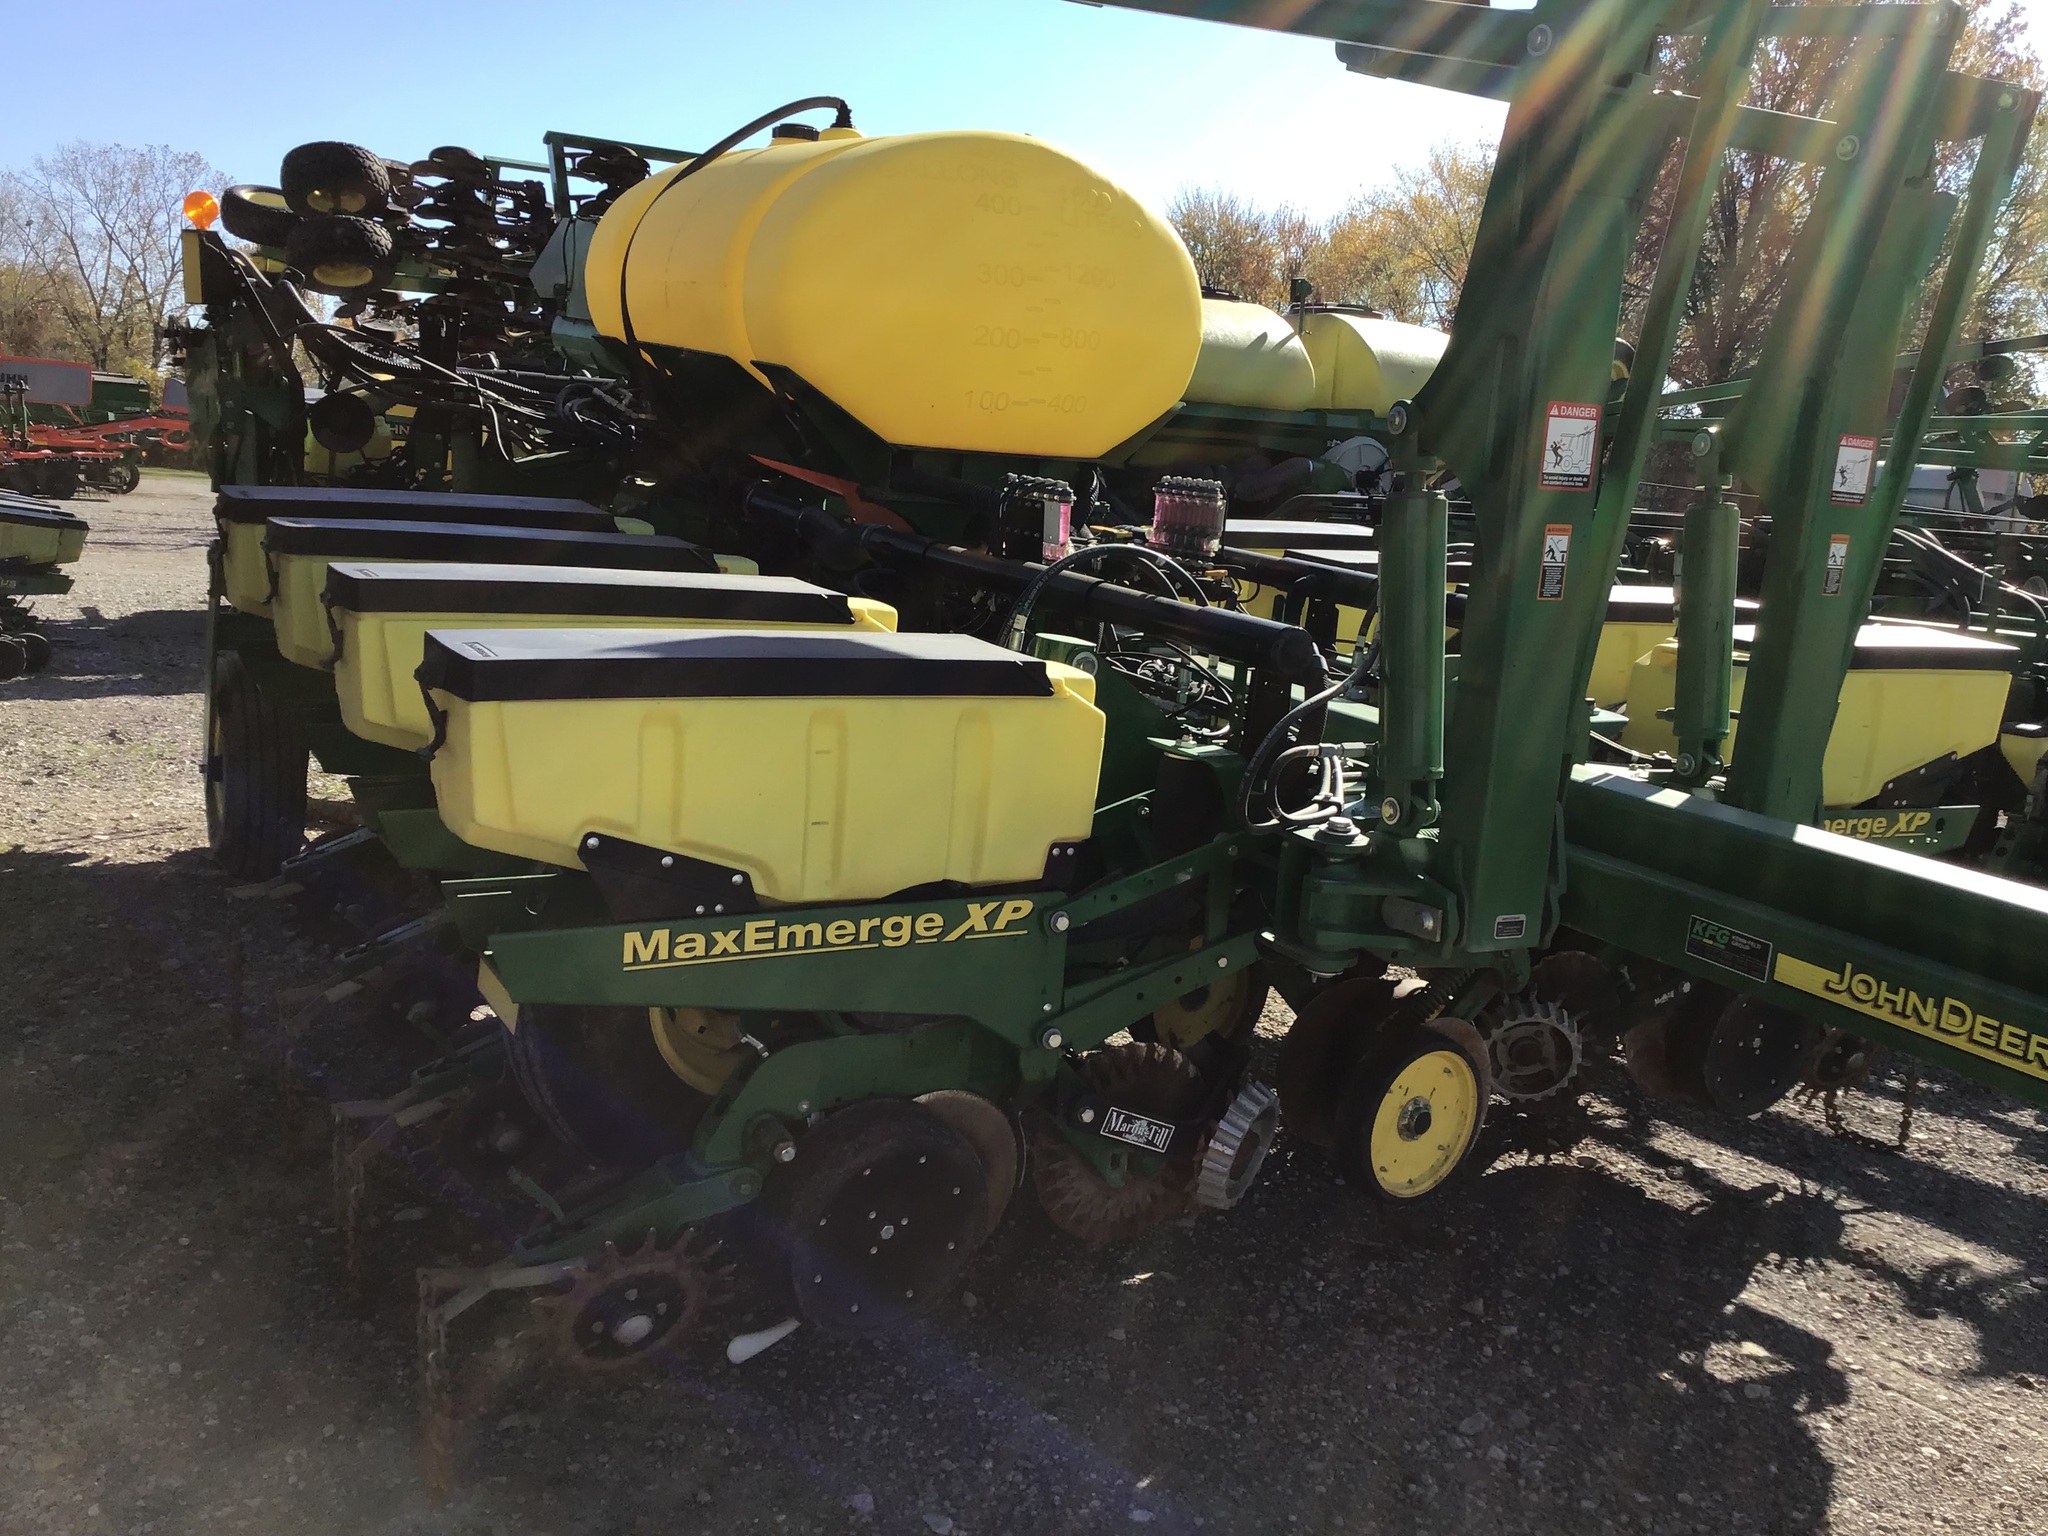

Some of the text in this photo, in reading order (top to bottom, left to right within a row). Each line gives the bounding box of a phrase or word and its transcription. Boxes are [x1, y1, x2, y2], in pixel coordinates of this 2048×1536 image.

[975, 192, 1023, 216] 400
[977, 263, 1025, 287] 300
[1064, 264, 1116, 289] 1200
[973, 325, 1021, 350] 200
[1059, 327, 1101, 350] 800
[964, 390, 1010, 411] 100
[1047, 393, 1088, 414] 400
[1560, 405, 1597, 418] DANGER
[1847, 437, 1875, 449] DANGER
[1884, 811, 1931, 838] XP
[622, 899, 1034, 964] MaxEmerge XP
[1692, 920, 1730, 945] KFG
[1827, 962, 1936, 1025] JOHN
[1148, 1125, 1169, 1149] Till
